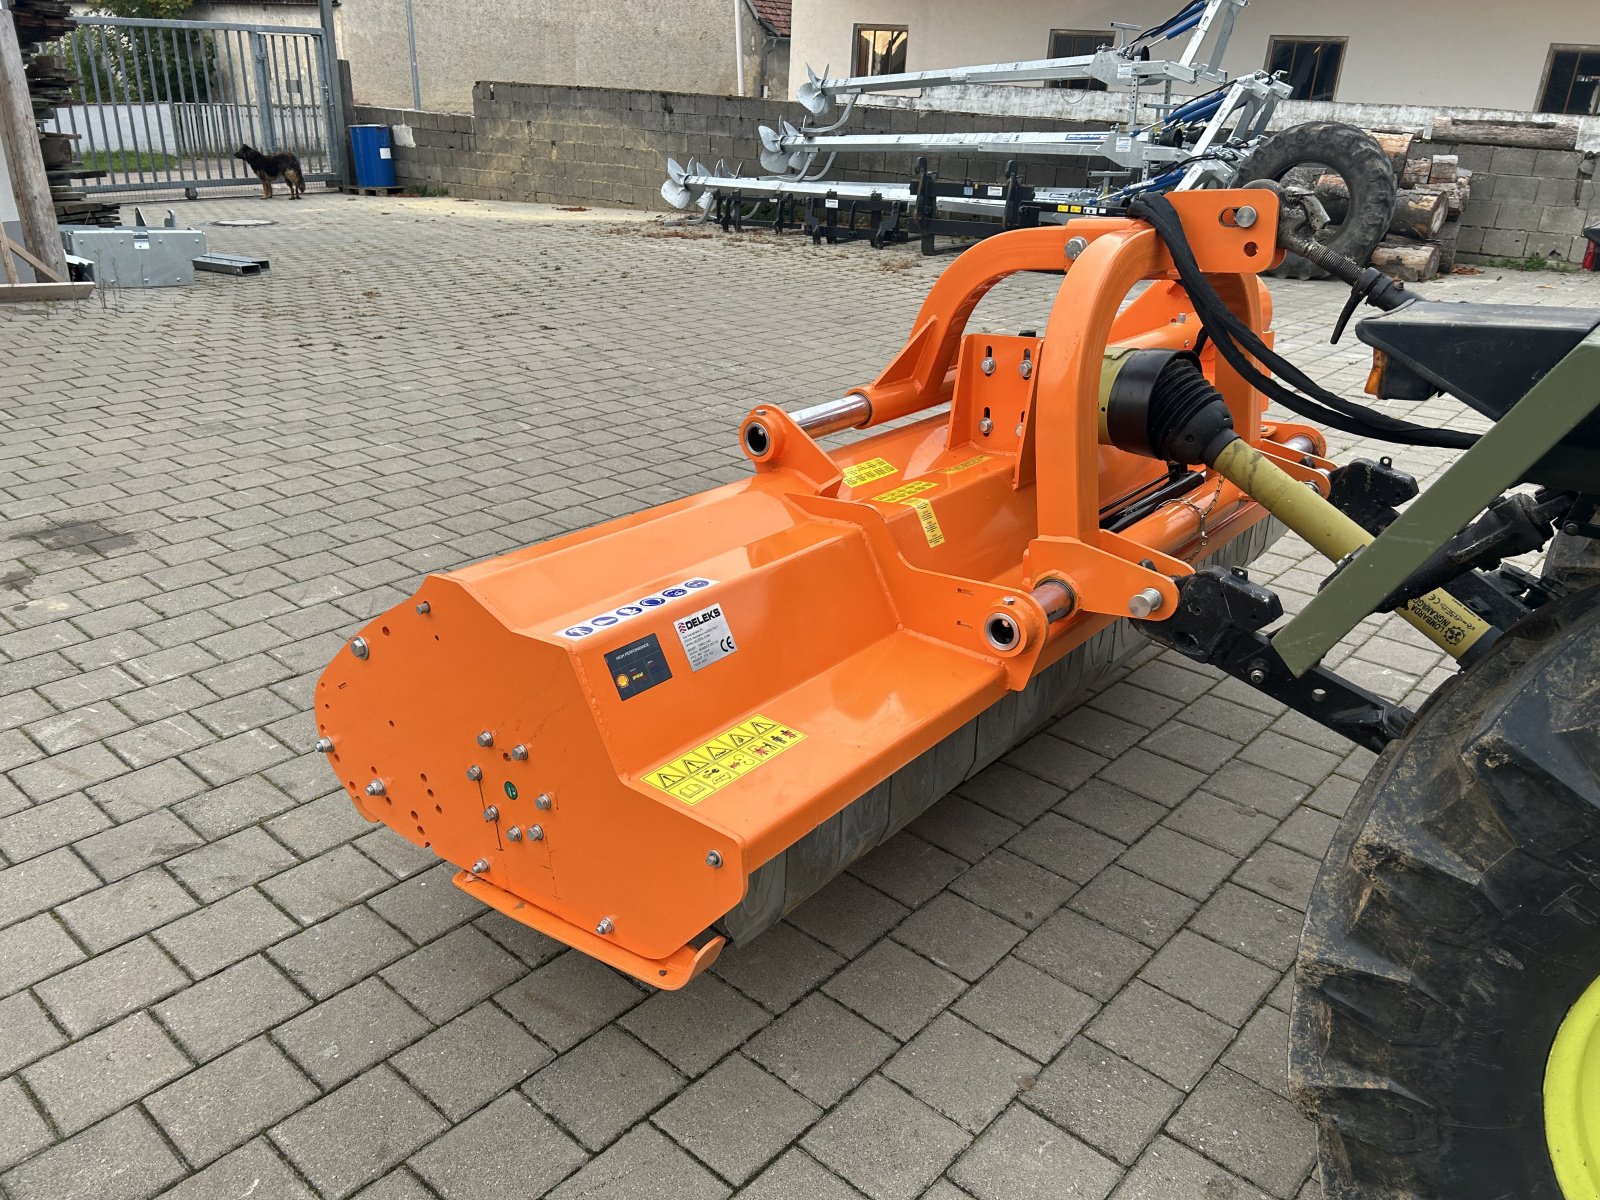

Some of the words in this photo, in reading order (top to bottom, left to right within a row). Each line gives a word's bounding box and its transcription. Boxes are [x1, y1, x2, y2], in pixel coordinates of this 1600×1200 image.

[685, 607, 721, 630] DELEKS
[1410, 597, 1451, 627] INGRANAGG
[1410, 603, 1445, 632] LOMBARDA
[720, 635, 735, 652] CE
